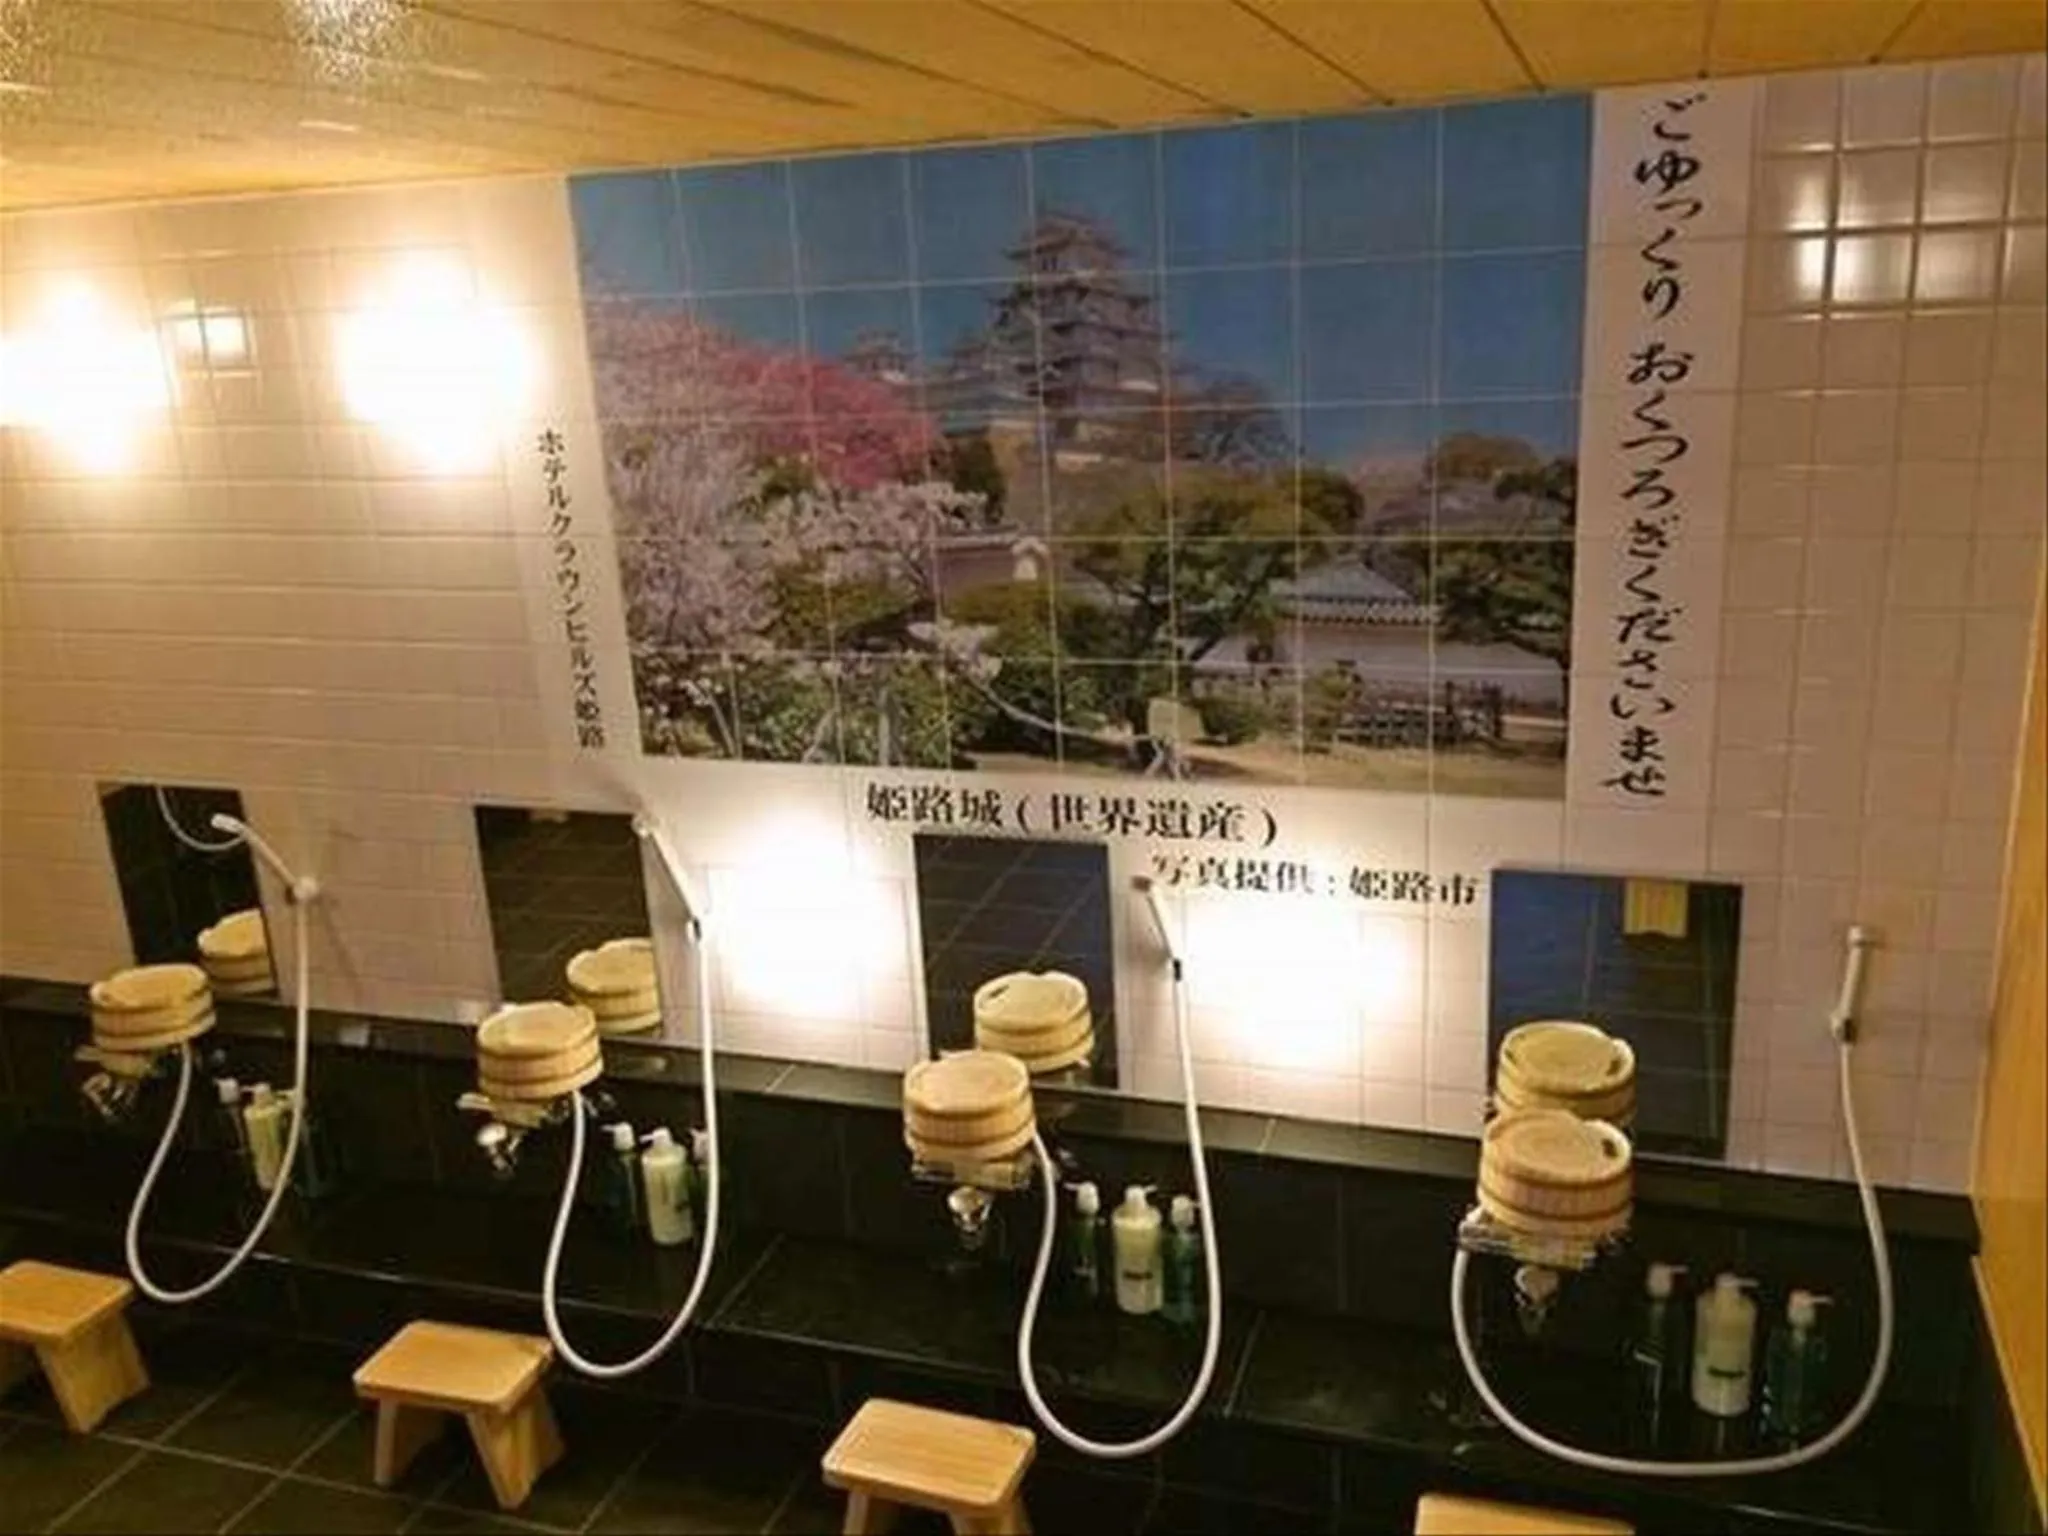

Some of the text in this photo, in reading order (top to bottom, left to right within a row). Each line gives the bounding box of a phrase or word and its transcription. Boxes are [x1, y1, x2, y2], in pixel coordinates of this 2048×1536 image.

[1601, 92, 1709, 798] ごゆっくり おくつろぎくださいませ
